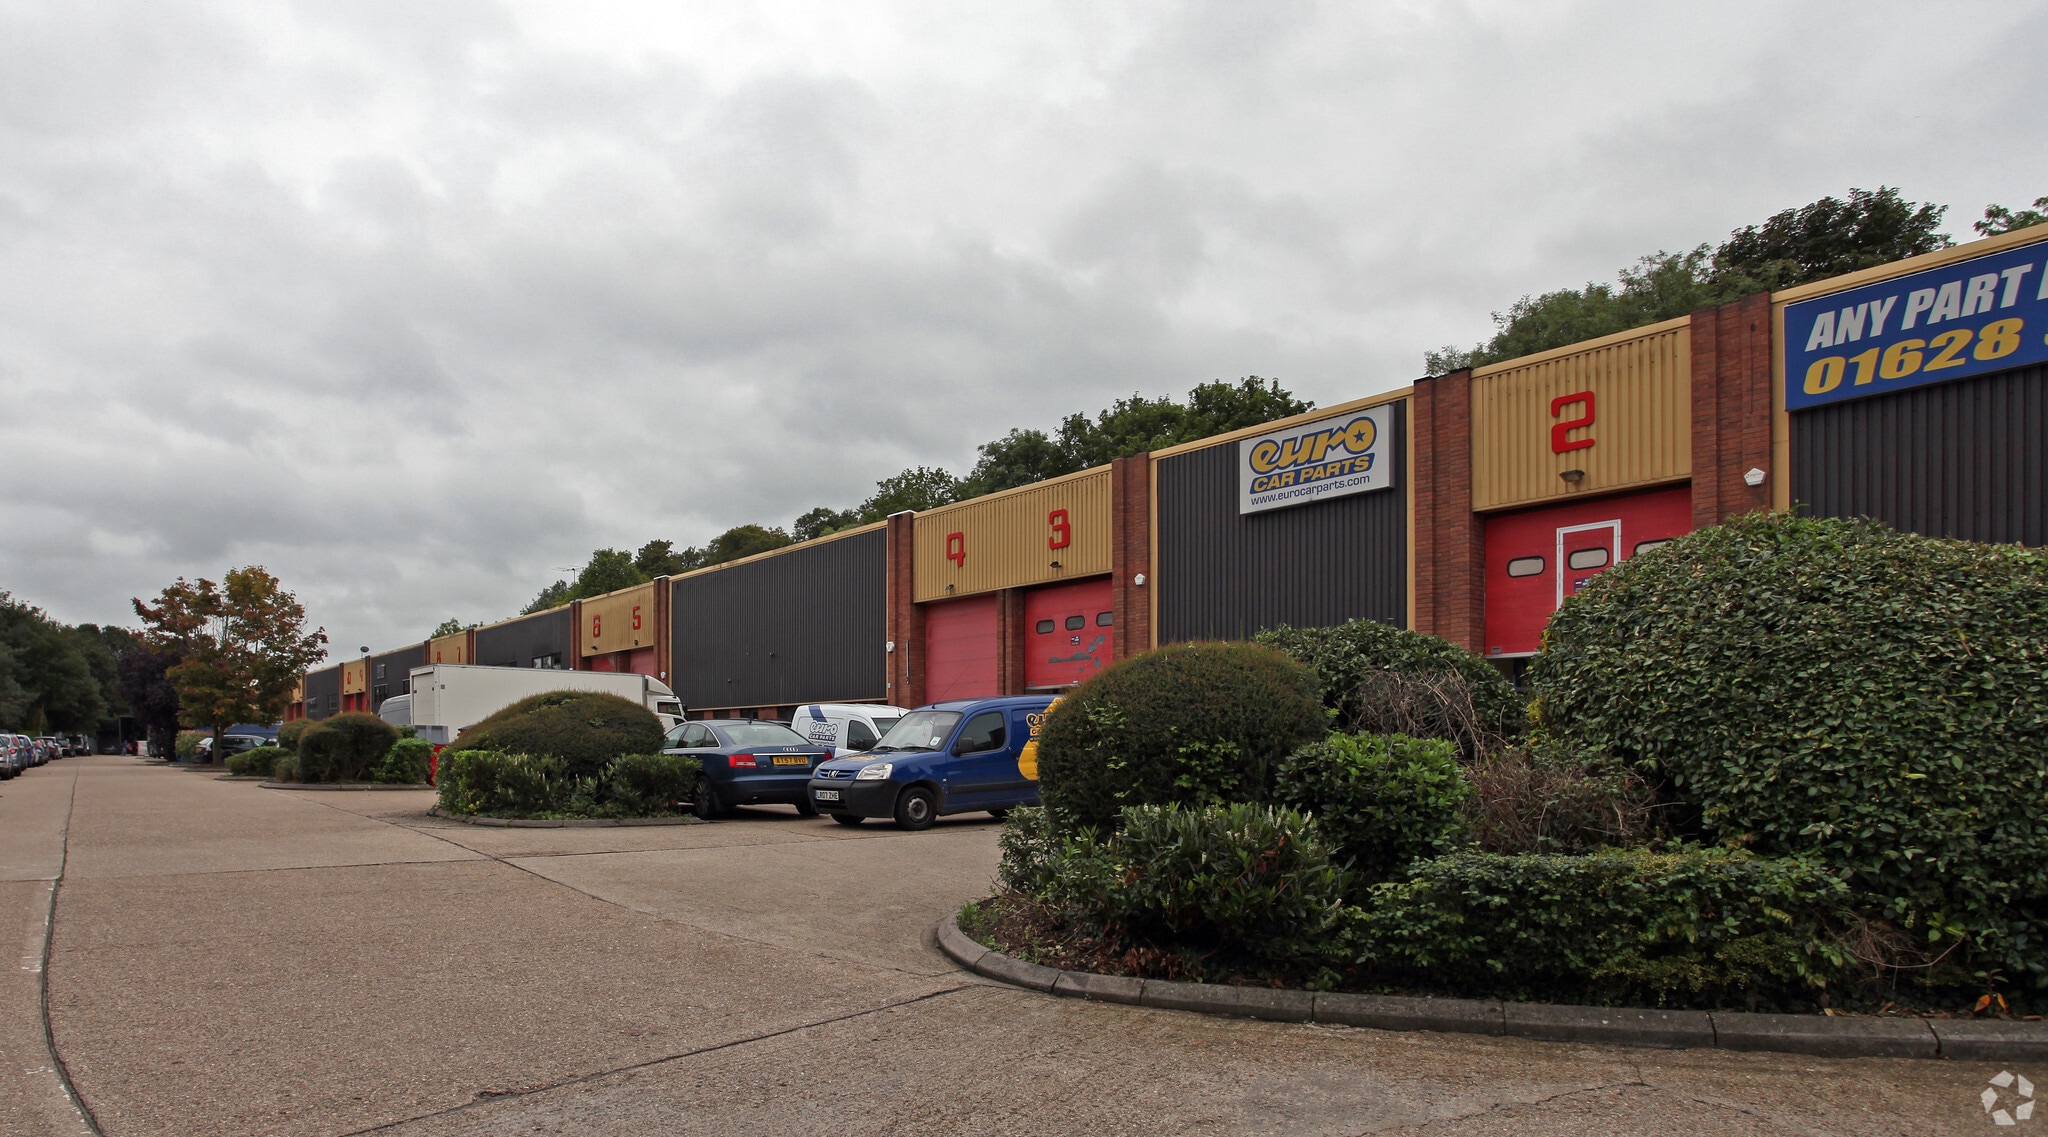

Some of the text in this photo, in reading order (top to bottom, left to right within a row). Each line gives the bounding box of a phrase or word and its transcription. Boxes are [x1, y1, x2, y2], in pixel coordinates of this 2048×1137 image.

[1804, 295, 1898, 352] ANY
[1901, 263, 2033, 330] PART
[1803, 317, 2024, 395] 01628
[1551, 391, 1595, 453] 2
[1249, 416, 1377, 475] euro
[1251, 475, 1370, 506] www.eurocarparts.com
[1253, 455, 1371, 492] CAR PARTS
[946, 531, 966, 567] 4
[1049, 509, 1070, 550] 3
[593, 615, 601, 638] 6
[632, 605, 641, 630] 5
